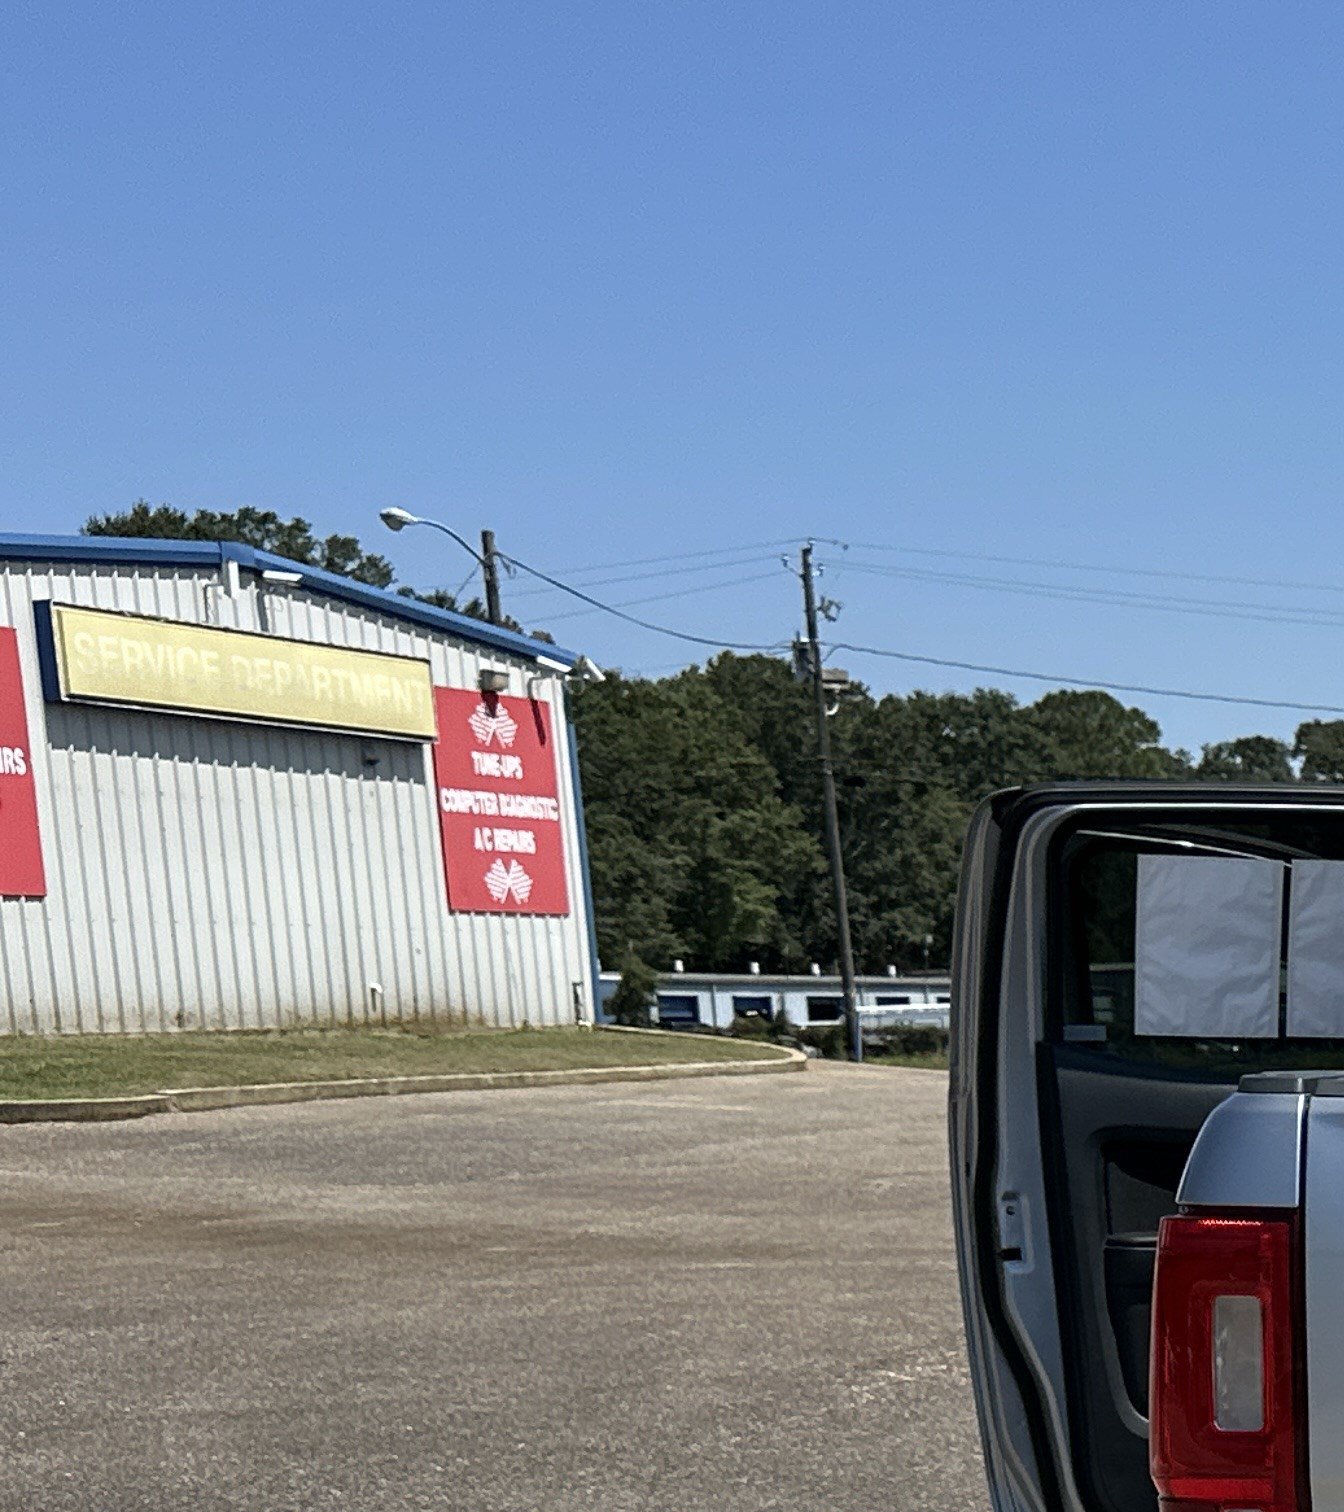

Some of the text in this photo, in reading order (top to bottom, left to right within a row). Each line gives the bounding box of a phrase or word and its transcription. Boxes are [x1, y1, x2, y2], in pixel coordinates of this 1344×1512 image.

[72, 631, 427, 718] SERVICE DEPARTMENT
[493, 828, 537, 855] REPAIRS
